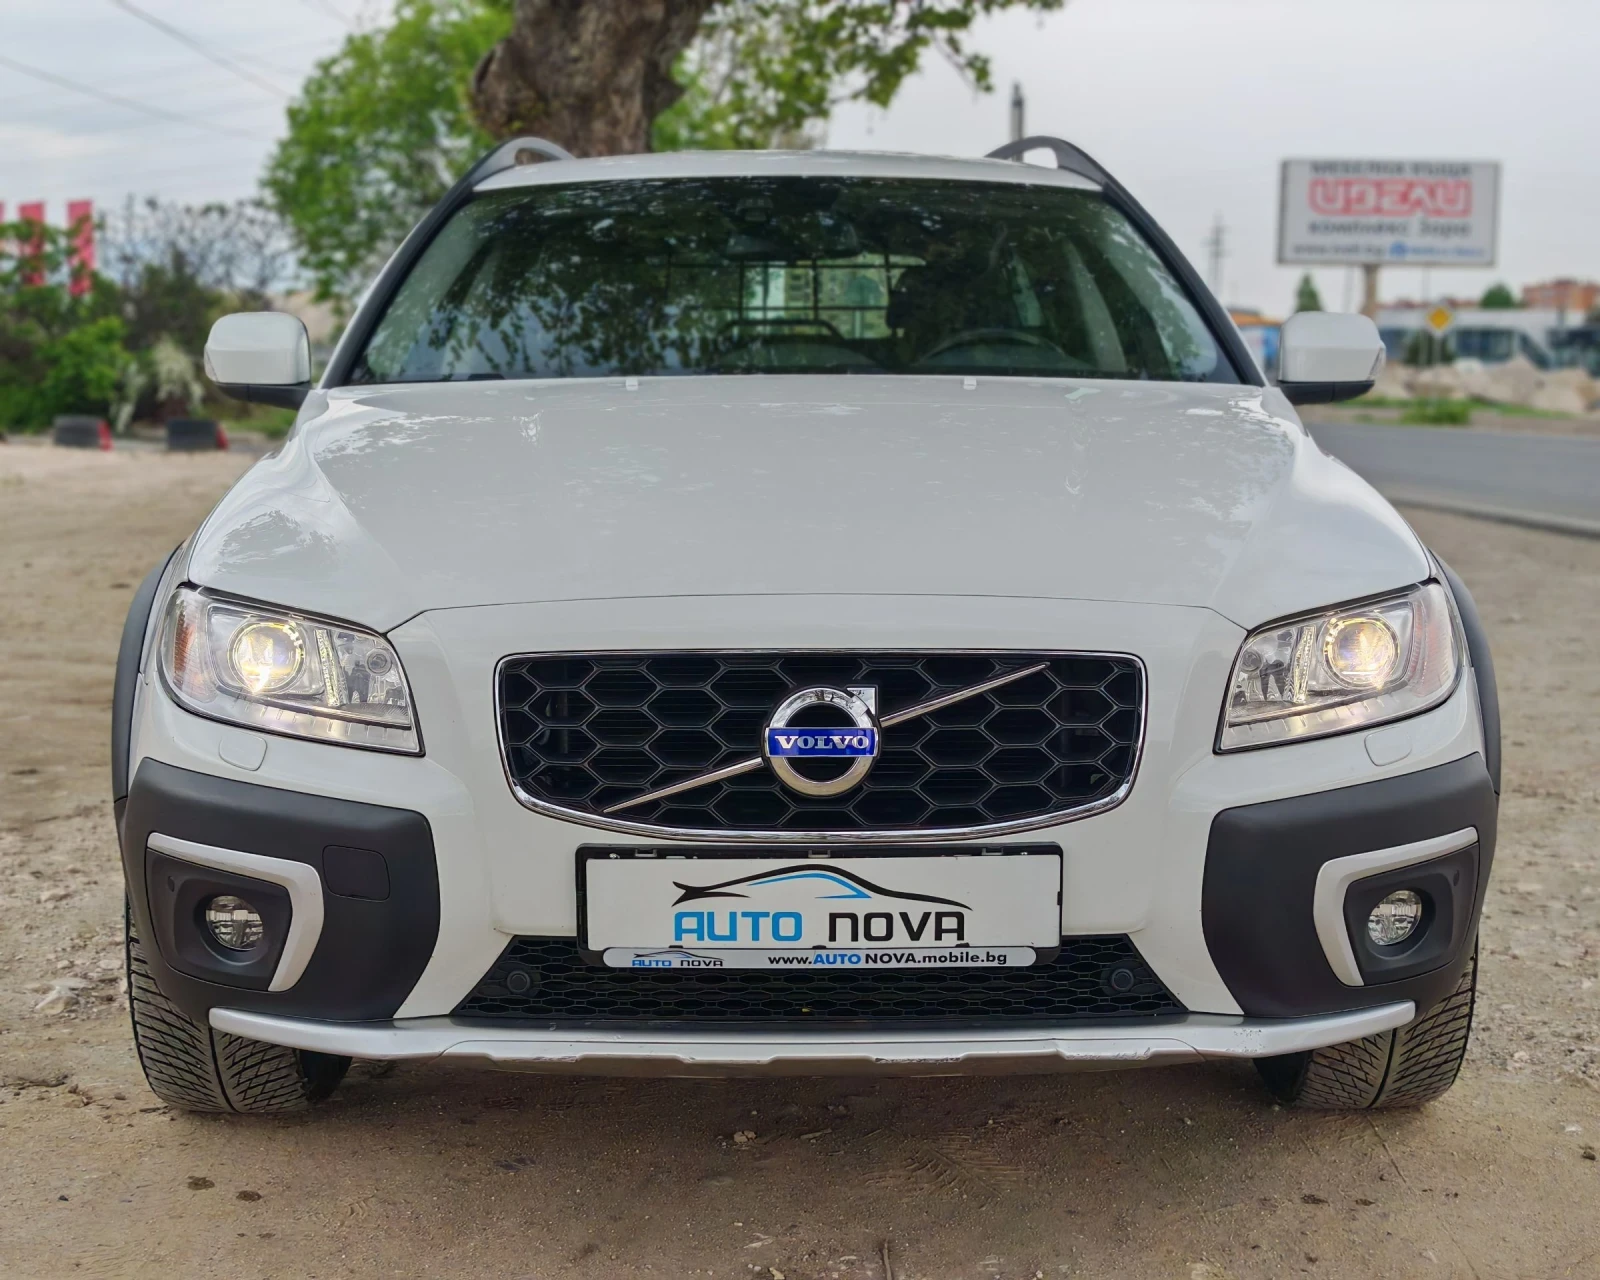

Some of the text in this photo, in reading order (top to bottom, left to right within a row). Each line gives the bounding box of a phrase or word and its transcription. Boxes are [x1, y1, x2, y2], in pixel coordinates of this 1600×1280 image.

[775, 735, 869, 749] VOLVO
[674, 911, 965, 942] AUTO NOVA
[631, 959, 723, 967] AUTO NOVA
